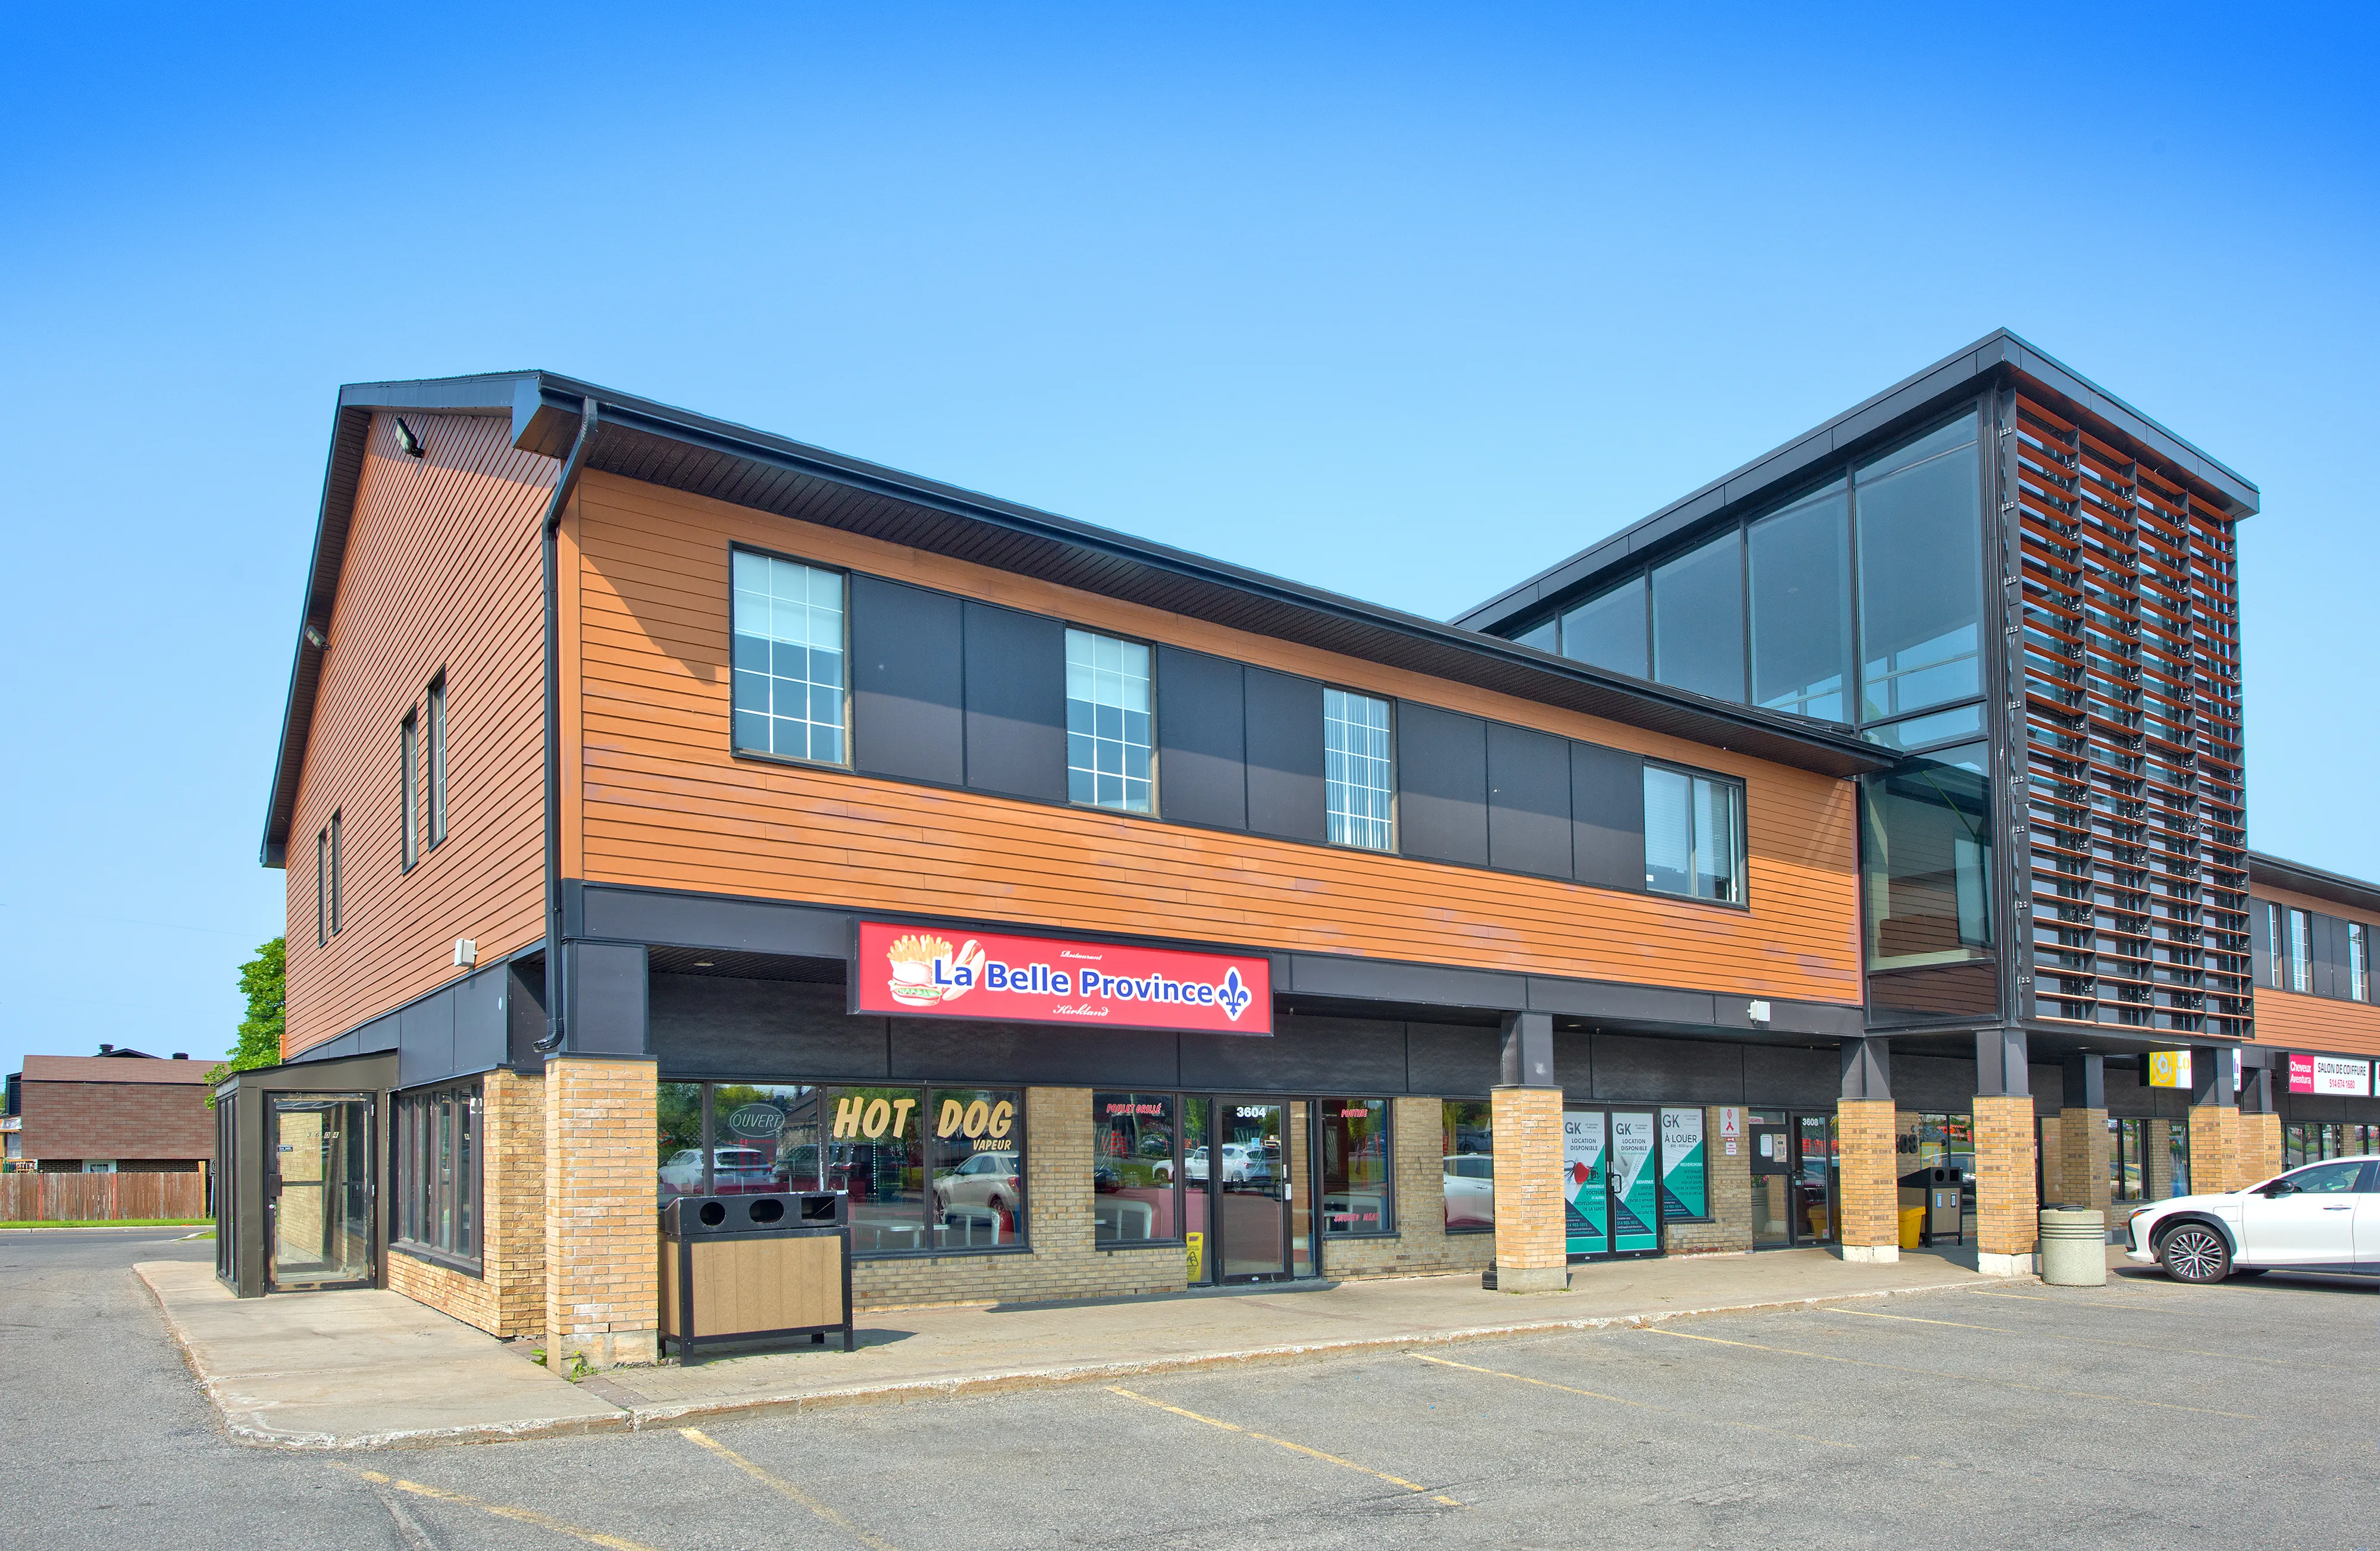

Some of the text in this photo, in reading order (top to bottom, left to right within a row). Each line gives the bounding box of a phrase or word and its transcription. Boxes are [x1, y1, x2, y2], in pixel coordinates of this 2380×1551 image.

[1060, 950, 1103, 960] Restaurant
[935, 960, 1213, 1003] La Belle Province
[1053, 1004, 1110, 1017] Kirkland
[2290, 1061, 2312, 1073] Cheveux
[2318, 1063, 2366, 1076] SALON DE COIFFURE
[2290, 1073, 2311, 1085] Aventura
[2345, 1080, 2355, 1089] 1680
[1107, 1102, 1162, 1114] POULET GRILLÉ
[1236, 1107, 1266, 1117] 3604
[1341, 1108, 1368, 1118] POUTINE
[733, 1114, 781, 1127] OUVERT
[833, 1096, 1013, 1138] HOT DOG
[1662, 1114, 1680, 1127] GK
[1565, 1121, 1582, 1134] GK
[1616, 1123, 1631, 1135] GK
[1665, 1133, 1670, 1142] À
[973, 1139, 1012, 1151] VAPEUR
[1334, 1212, 1380, 1222] SMOKED MEAT
